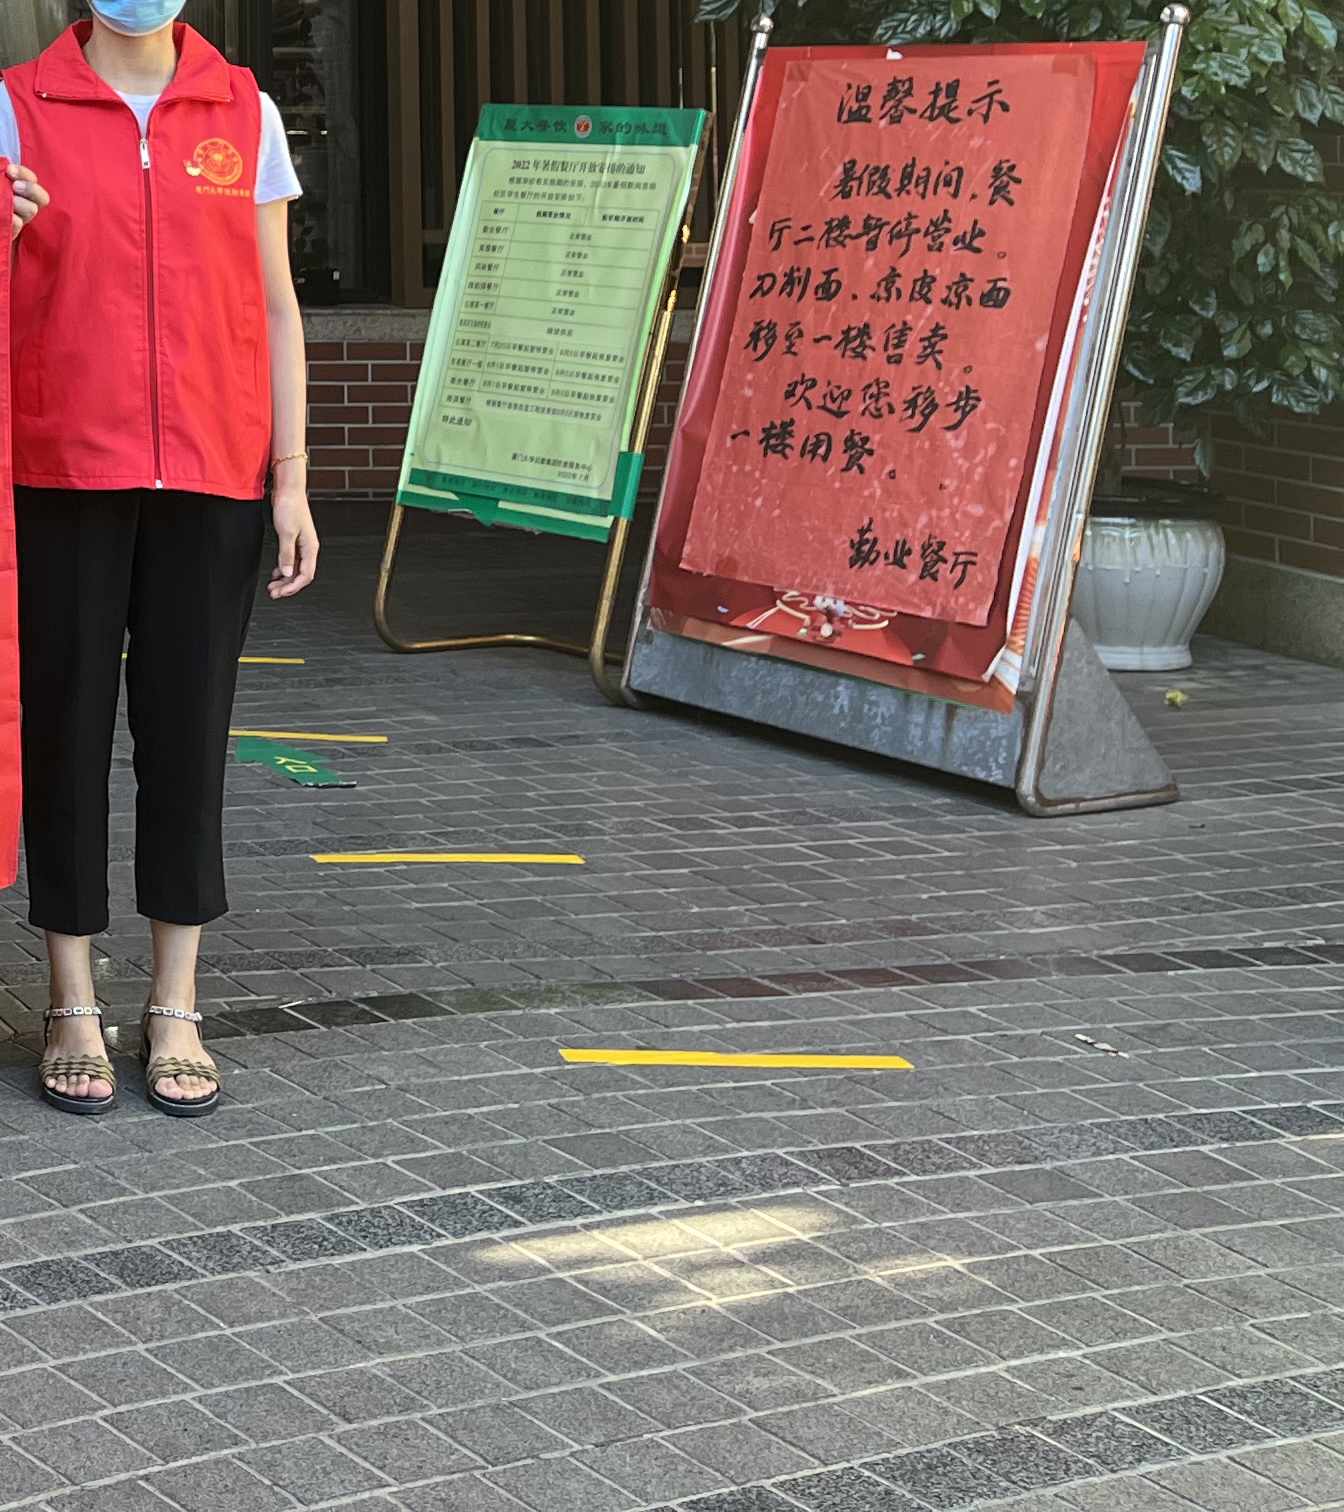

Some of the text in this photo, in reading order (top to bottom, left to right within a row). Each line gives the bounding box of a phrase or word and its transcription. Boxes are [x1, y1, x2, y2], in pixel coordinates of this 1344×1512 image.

[837, 76, 1010, 124] 温馨提示
[784, 373, 982, 433] 欢迎您移步
[849, 517, 978, 589] 勤业餐厅
